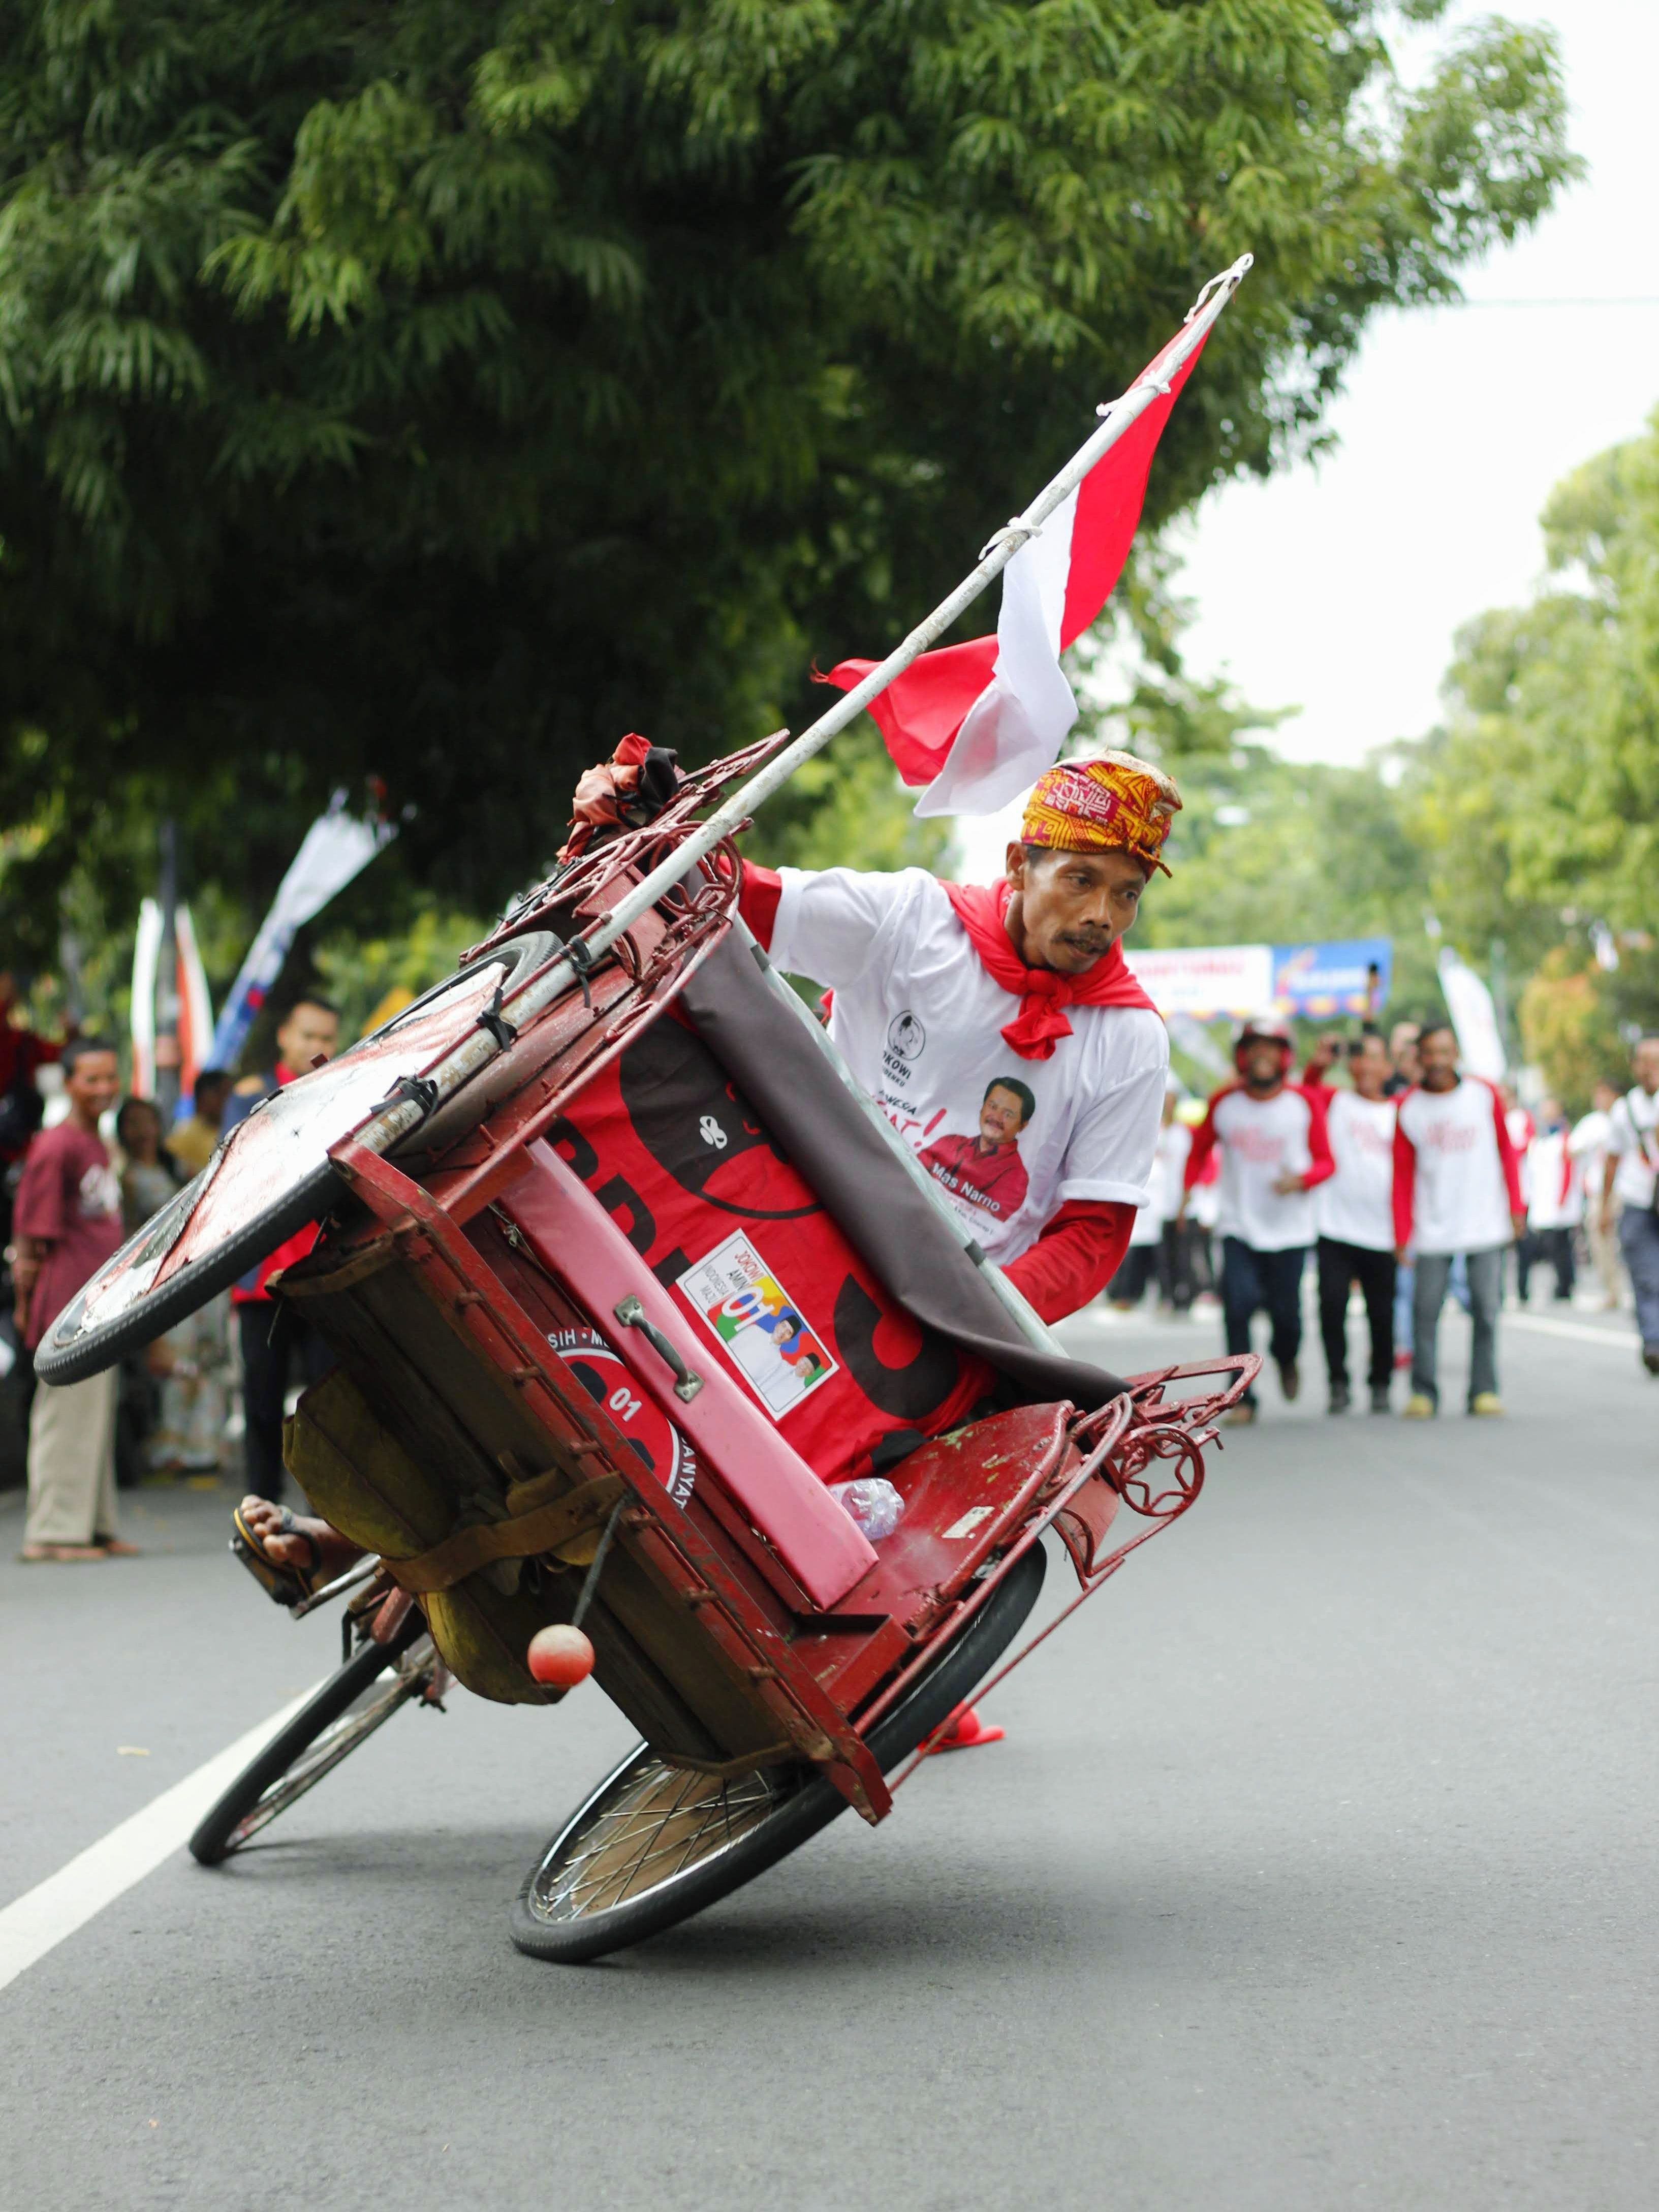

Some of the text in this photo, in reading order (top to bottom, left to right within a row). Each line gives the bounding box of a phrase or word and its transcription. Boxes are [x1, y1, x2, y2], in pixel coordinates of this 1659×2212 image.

[933, 1162, 958, 1189] Mas
[960, 1181, 1000, 1212] Narno
[726, 1269, 749, 1291] AMIN
[734, 1250, 765, 1283] JOKOWI
[722, 1286, 775, 1332] 01
[609, 1387, 642, 1422] 01
